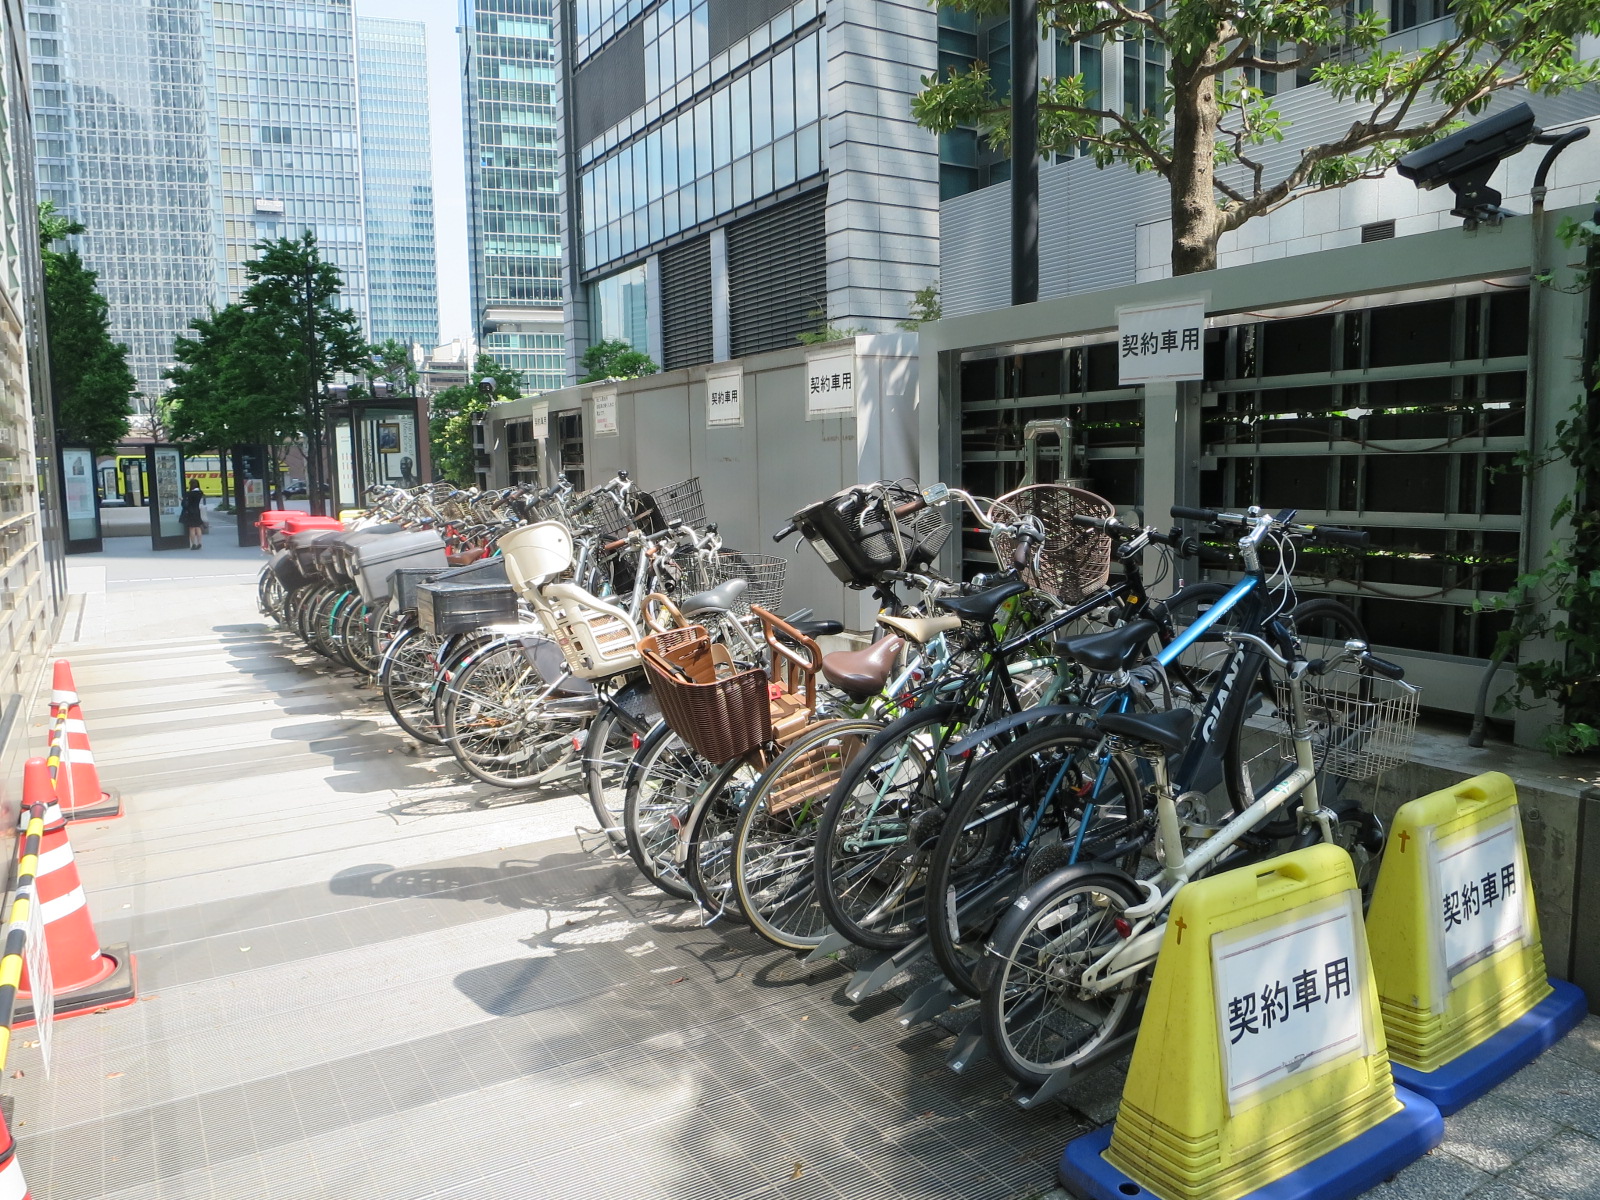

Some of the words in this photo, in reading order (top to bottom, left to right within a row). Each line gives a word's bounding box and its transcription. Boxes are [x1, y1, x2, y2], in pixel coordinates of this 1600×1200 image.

[1122, 327, 1199, 358] 契約車用
[711, 389, 738, 406] 契約車用
[810, 372, 852, 395] 契約車用
[1202, 642, 1245, 744] GIANT
[1443, 862, 1516, 934] 契約車用
[1228, 956, 1351, 1045] 契約車用
